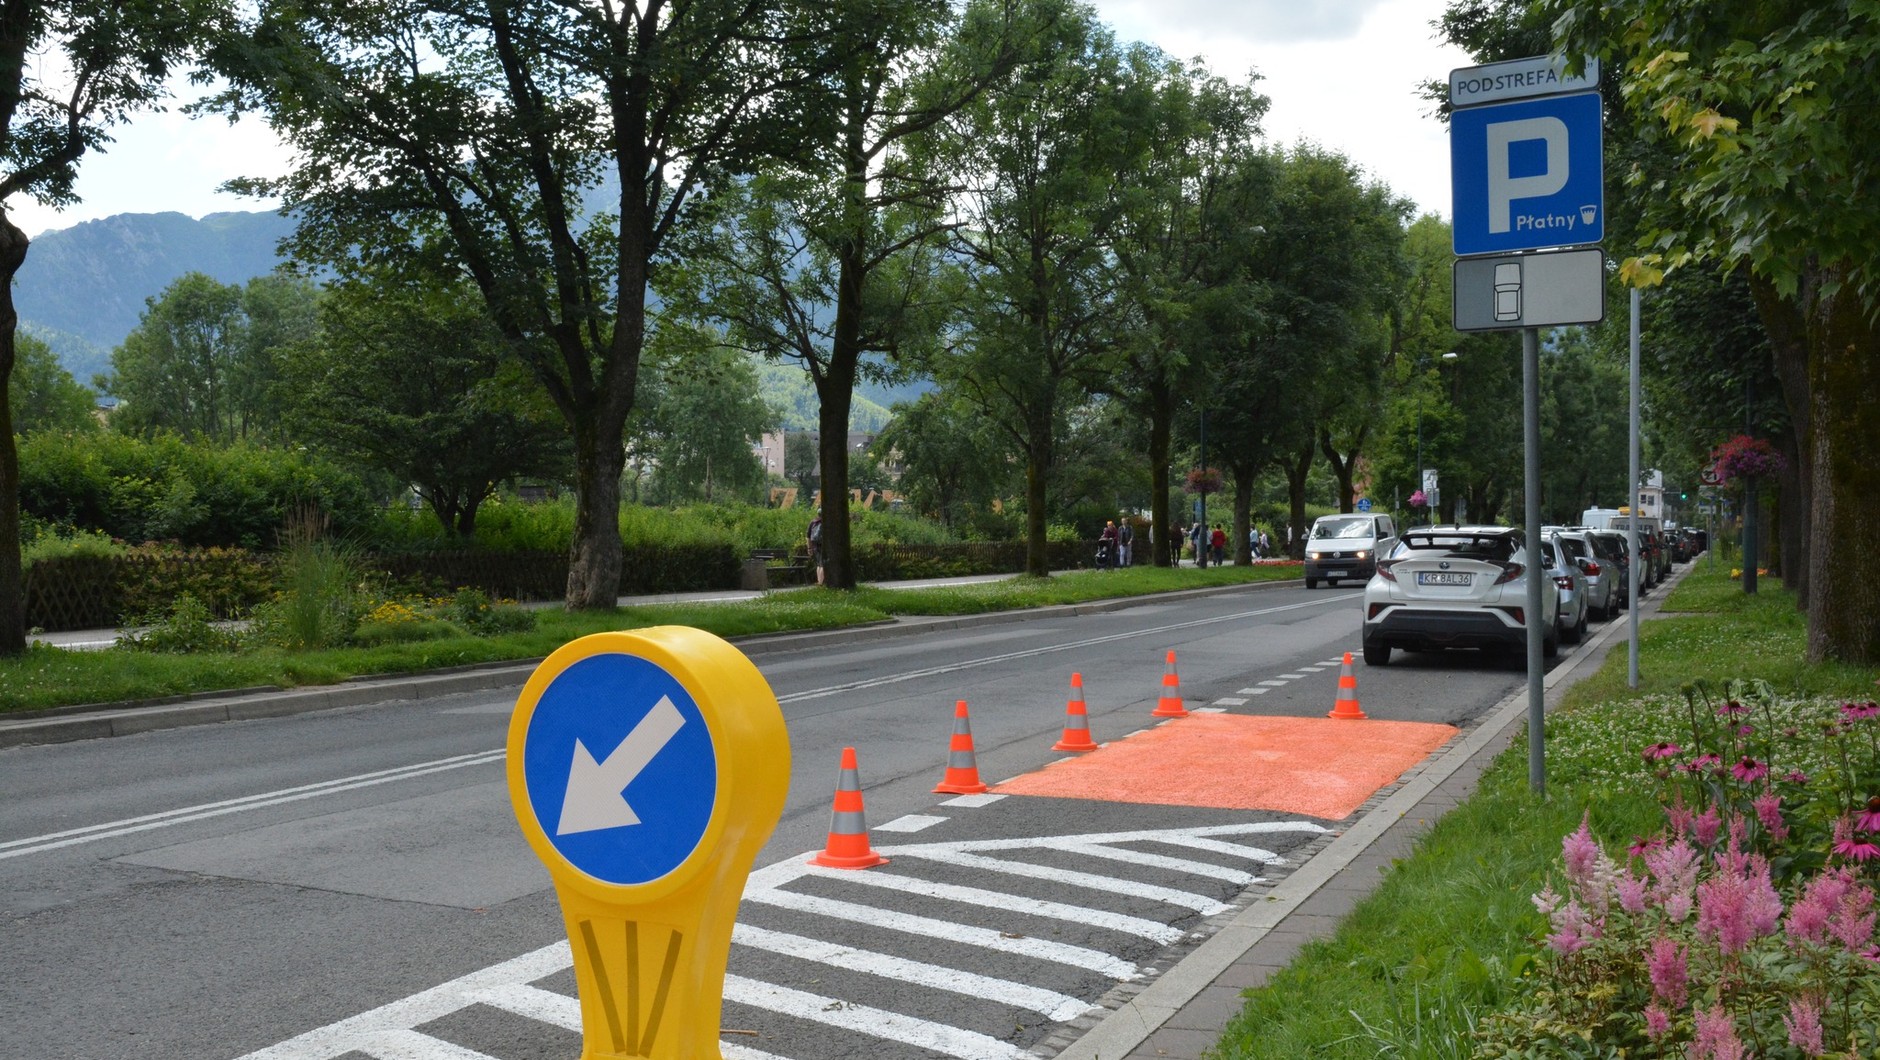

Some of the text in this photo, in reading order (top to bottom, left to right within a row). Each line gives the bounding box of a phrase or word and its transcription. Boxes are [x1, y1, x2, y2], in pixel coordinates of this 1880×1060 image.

[1457, 68, 1557, 95] PODSTREFA
[1486, 116, 1570, 234] P
[1516, 212, 1576, 231] Płatny
[1424, 573, 1469, 584] KR 8AL36
